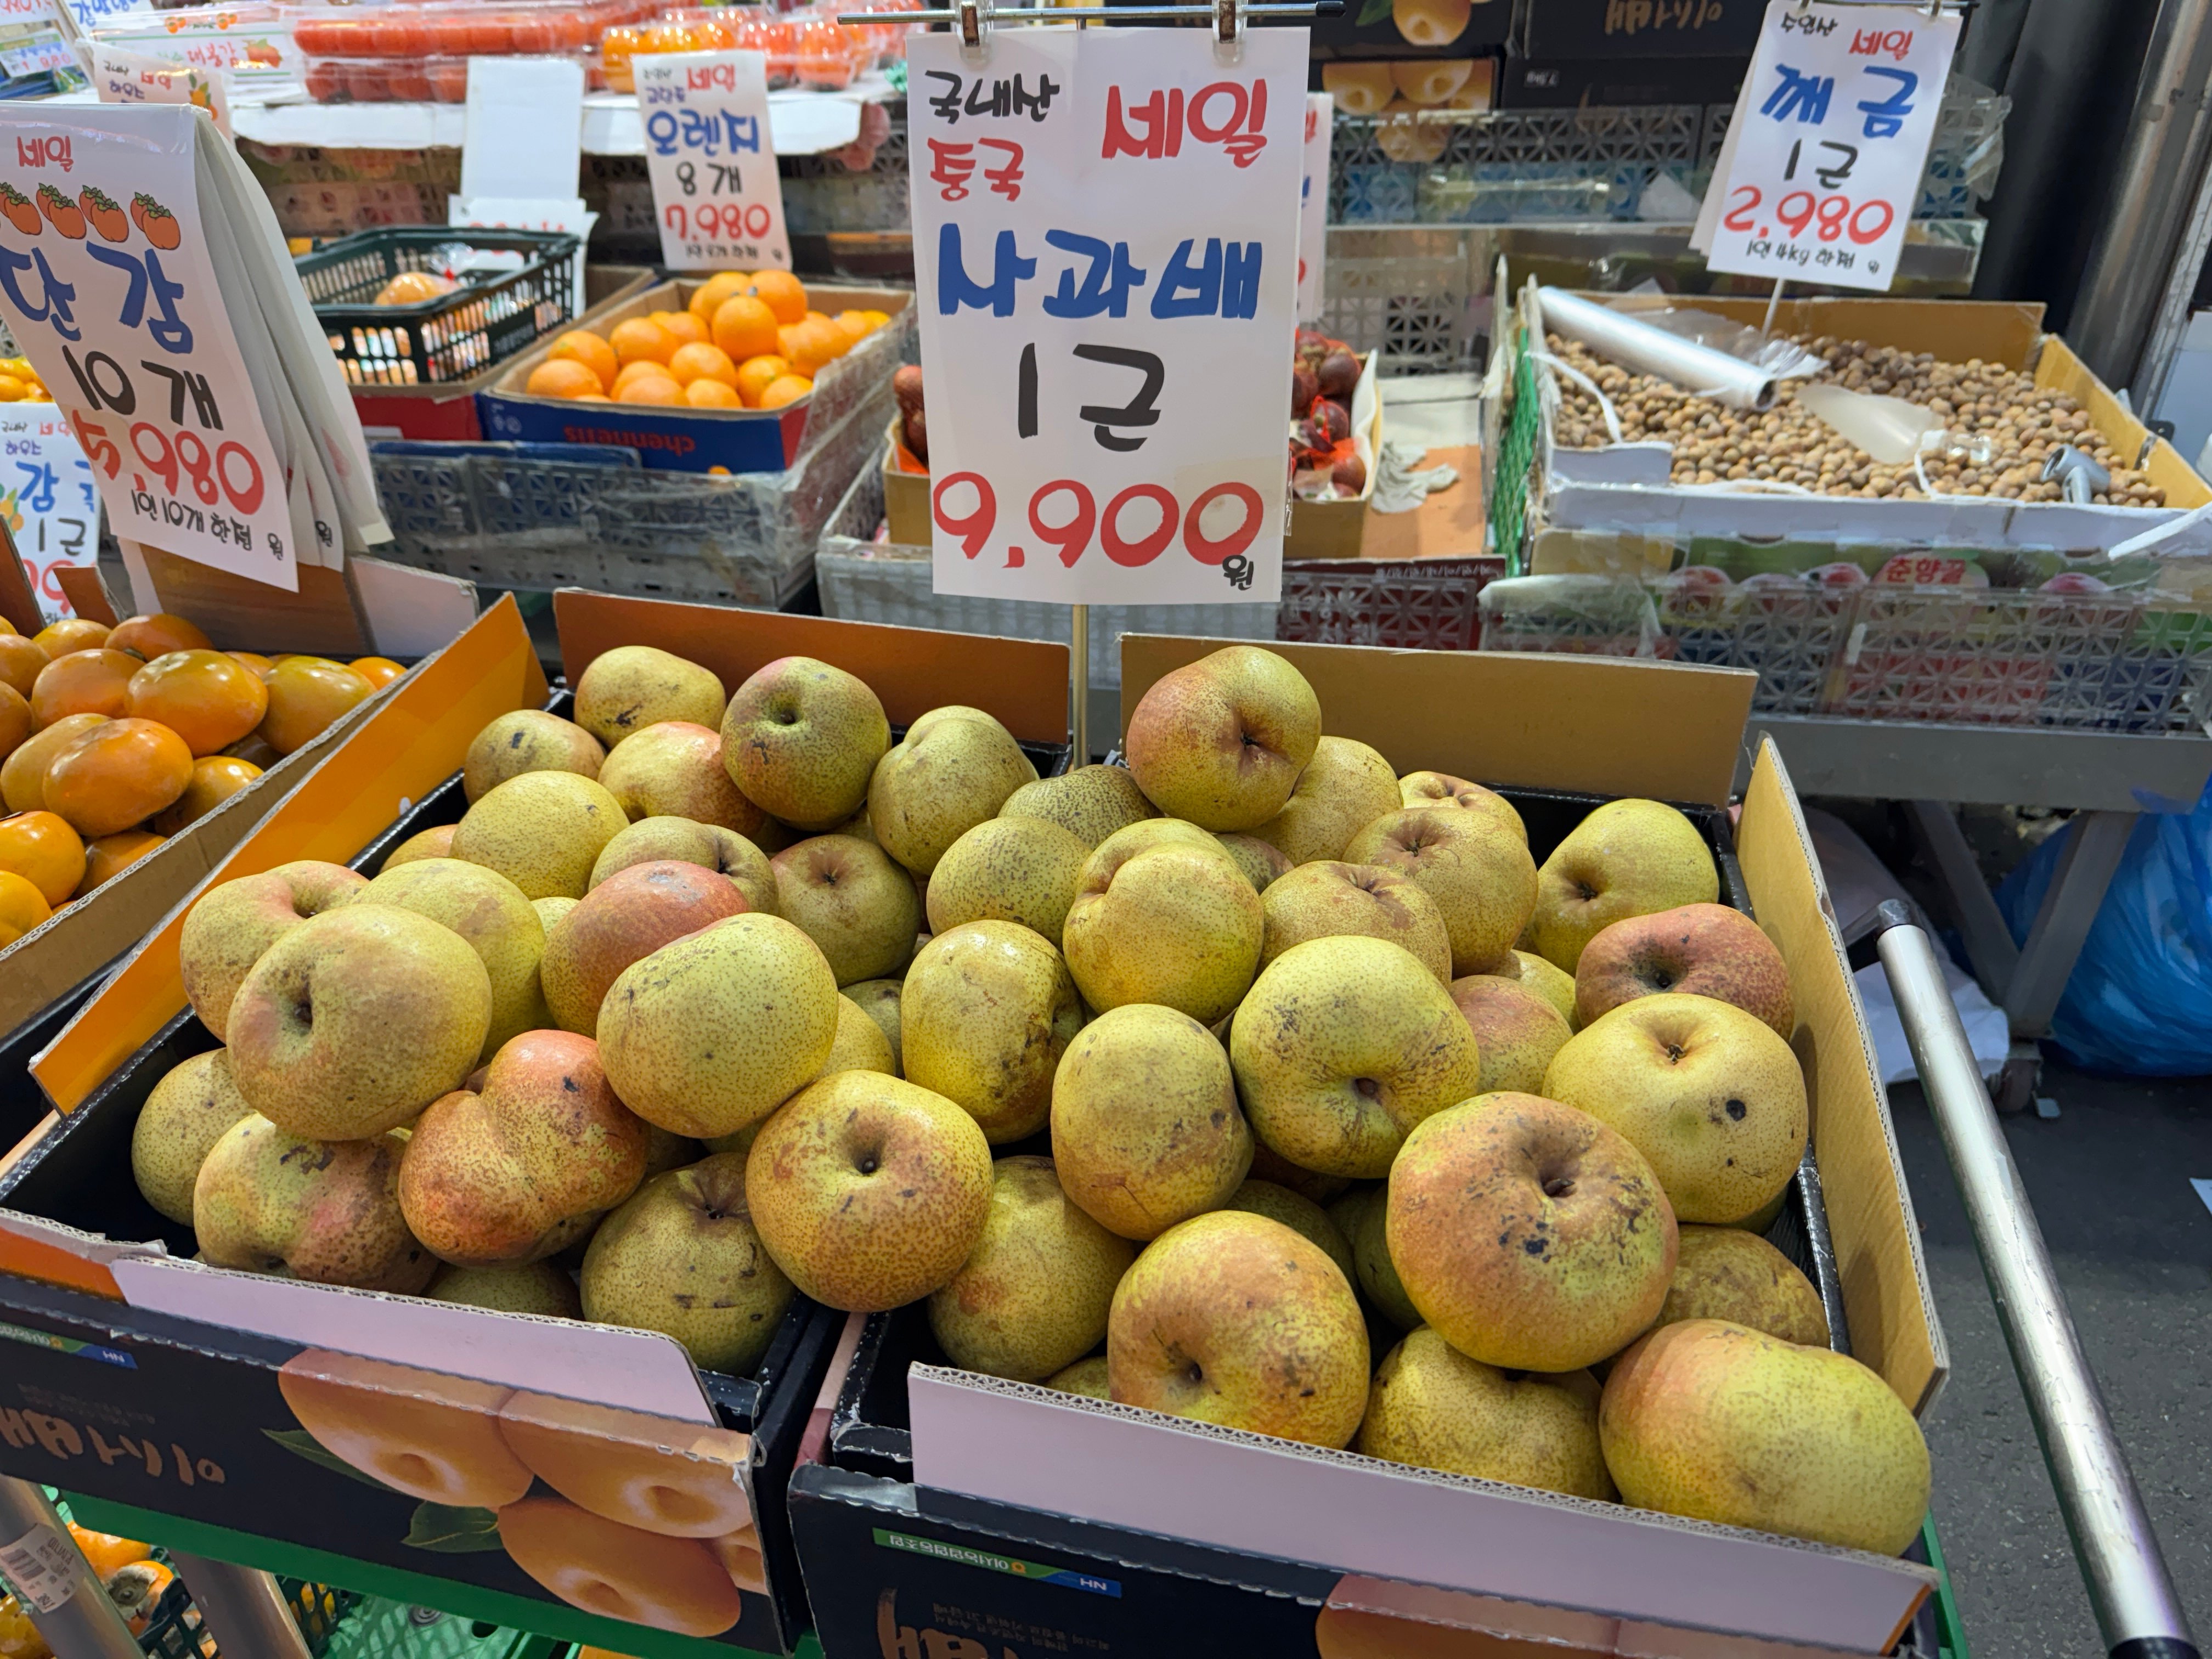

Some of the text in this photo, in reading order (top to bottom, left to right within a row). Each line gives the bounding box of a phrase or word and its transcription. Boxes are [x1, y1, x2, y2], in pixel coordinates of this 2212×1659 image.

[1849, 29, 1914, 61] 세일
[687, 64, 736, 93] 세일
[925, 70, 1059, 124] 국내산
[1760, 64, 1918, 138] 깨금
[647, 109, 759, 156] 오렌지
[1102, 78, 1268, 168] 세일
[16, 136, 74, 173] 세일
[939, 223, 1263, 320] 사과배
[5, 439, 42, 455] 하우스
[72, 410, 264, 515] 5,980
[132, 489, 252, 551] 1인 10개 한정
[933, 471, 1264, 568] 9,900
[268, 533, 284, 560] 원
[1222, 555, 1255, 590] 원
[1080, 1577, 1107, 1590] NH
